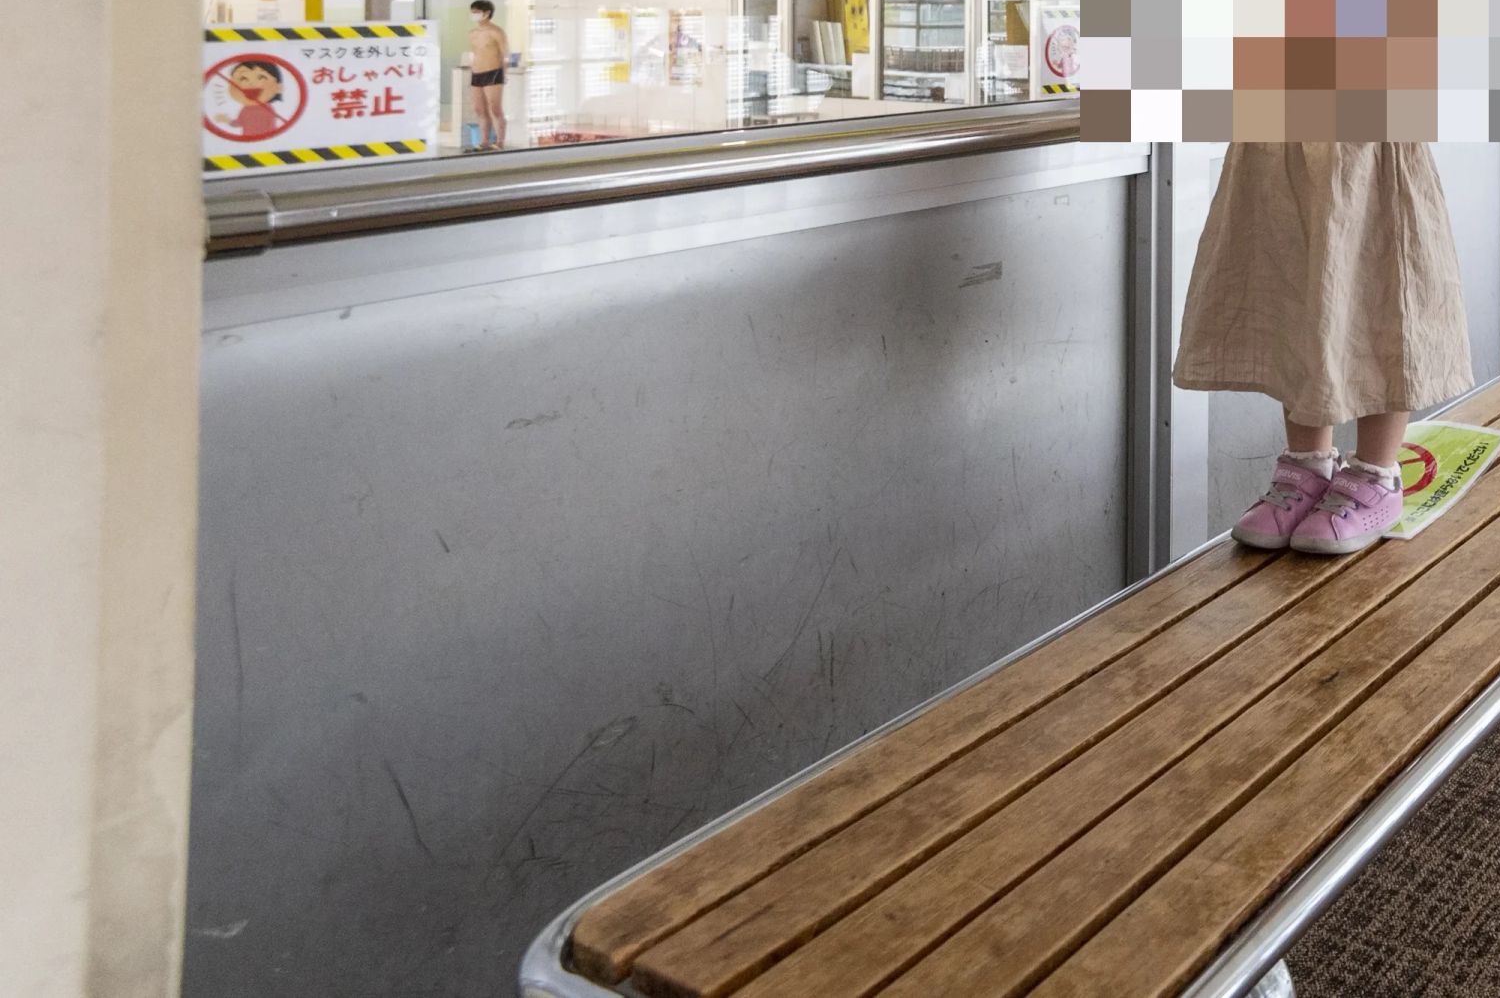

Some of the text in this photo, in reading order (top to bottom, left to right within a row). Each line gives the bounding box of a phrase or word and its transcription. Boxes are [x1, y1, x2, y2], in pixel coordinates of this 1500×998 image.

[301, 45, 428, 59] マスクを外しての
[312, 63, 424, 84] おしゃべり
[330, 87, 406, 119] 禁止
